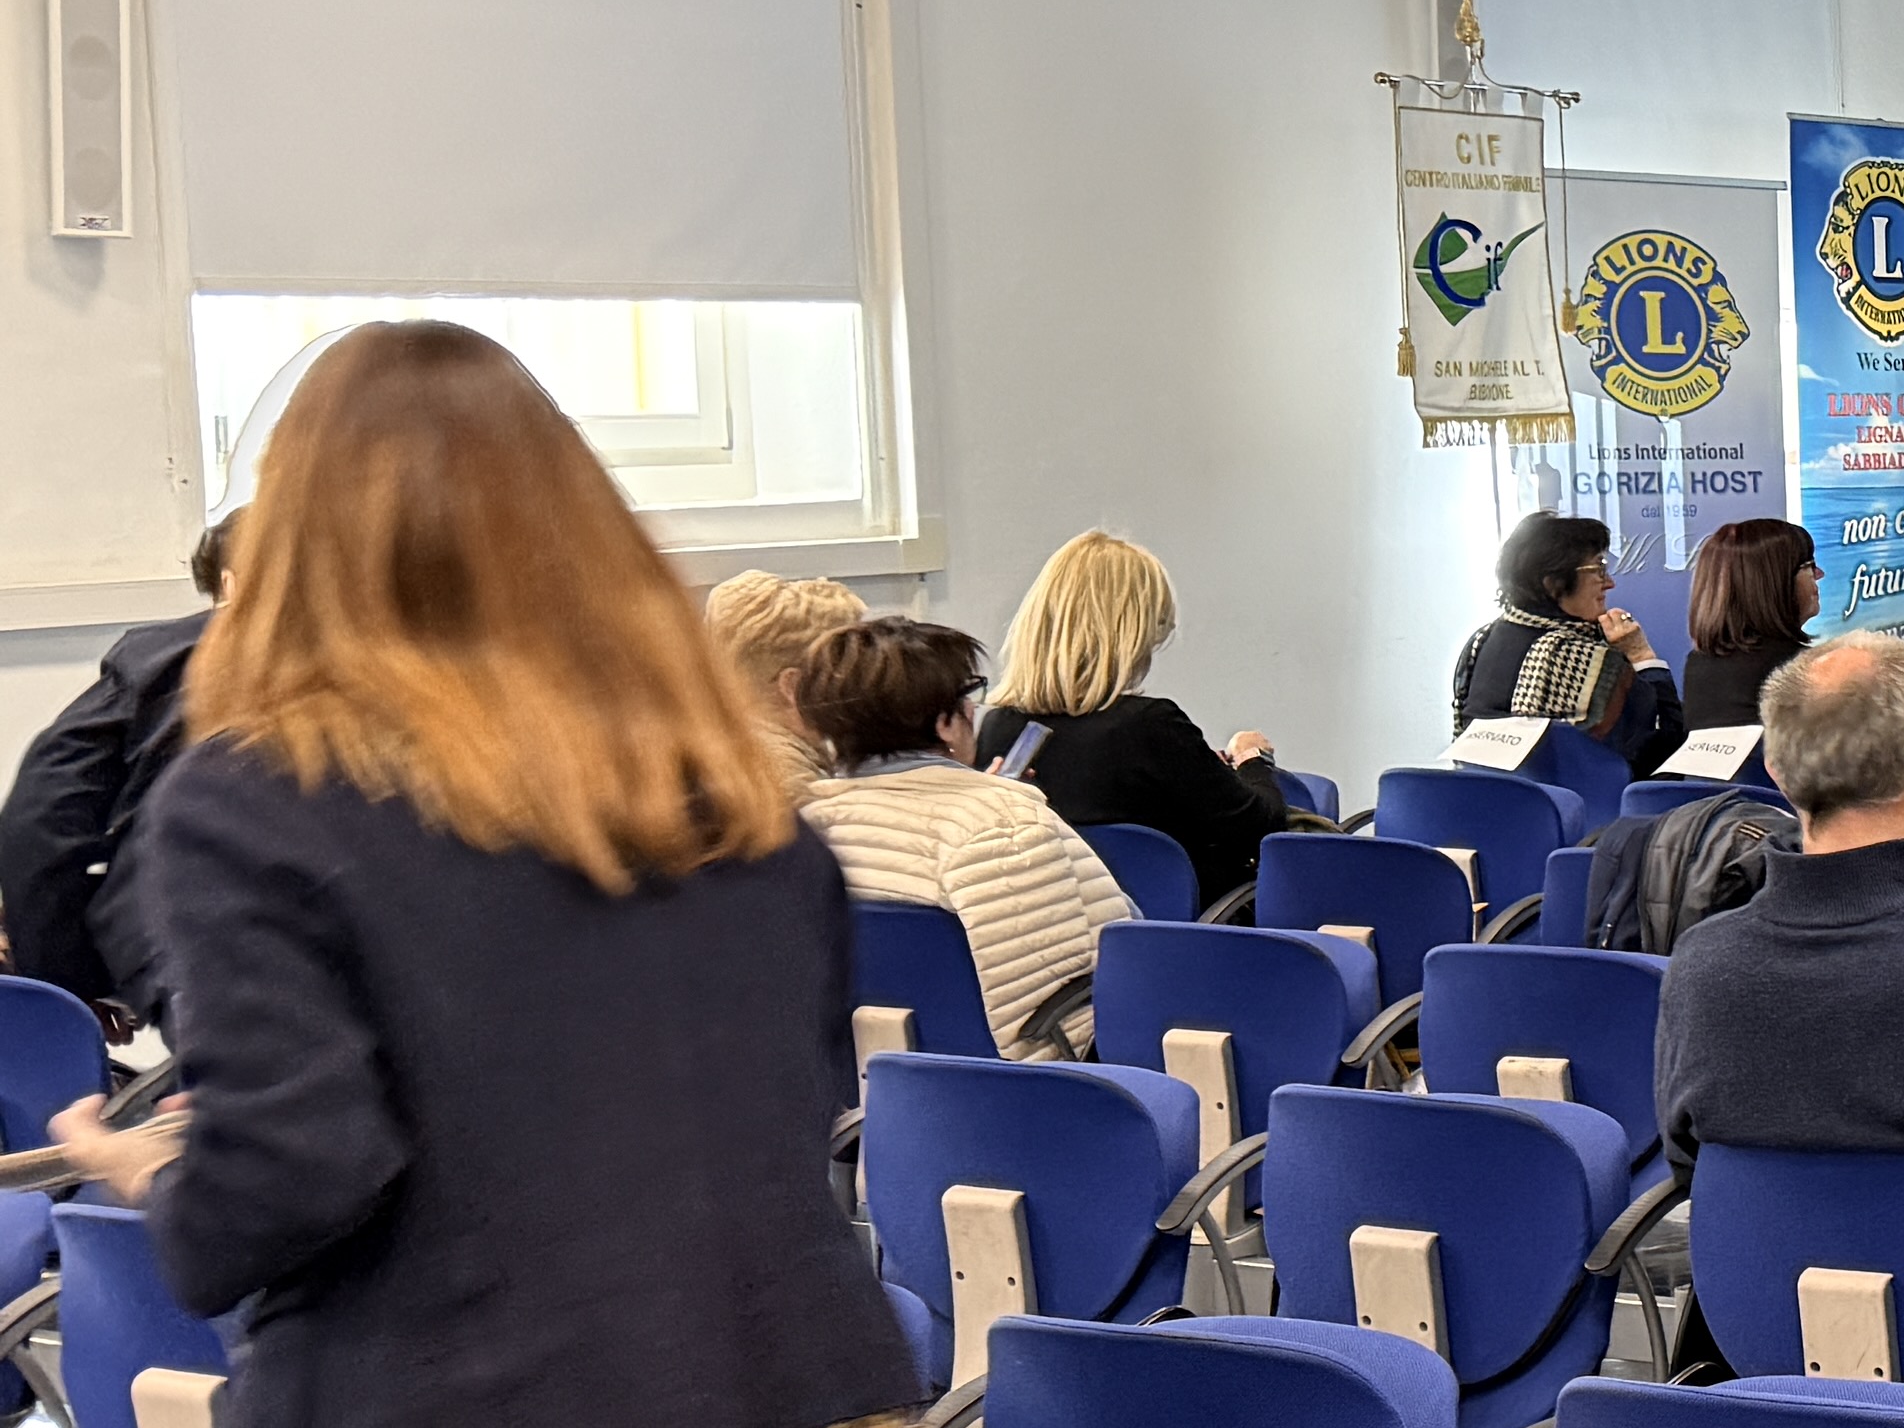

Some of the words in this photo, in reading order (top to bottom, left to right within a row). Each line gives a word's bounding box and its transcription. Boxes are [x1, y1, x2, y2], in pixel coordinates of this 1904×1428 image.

[1456, 132, 1502, 166] CIF
[1603, 237, 1708, 279] LIONS
[1872, 216, 1903, 278] L
[1639, 291, 1687, 354] L
[1435, 361, 1463, 377] SAN
[1513, 361, 1530, 377] AL
[1857, 352, 1880, 371] We
[1611, 372, 1713, 407] INTERNATIONAL
[1827, 393, 1892, 417] LIONS
[1589, 443, 1631, 461] Lions
[1636, 443, 1744, 461] International
[1573, 471, 1683, 495] GORIZIA
[1691, 471, 1763, 494] HOST
[1842, 514, 1886, 545] non
